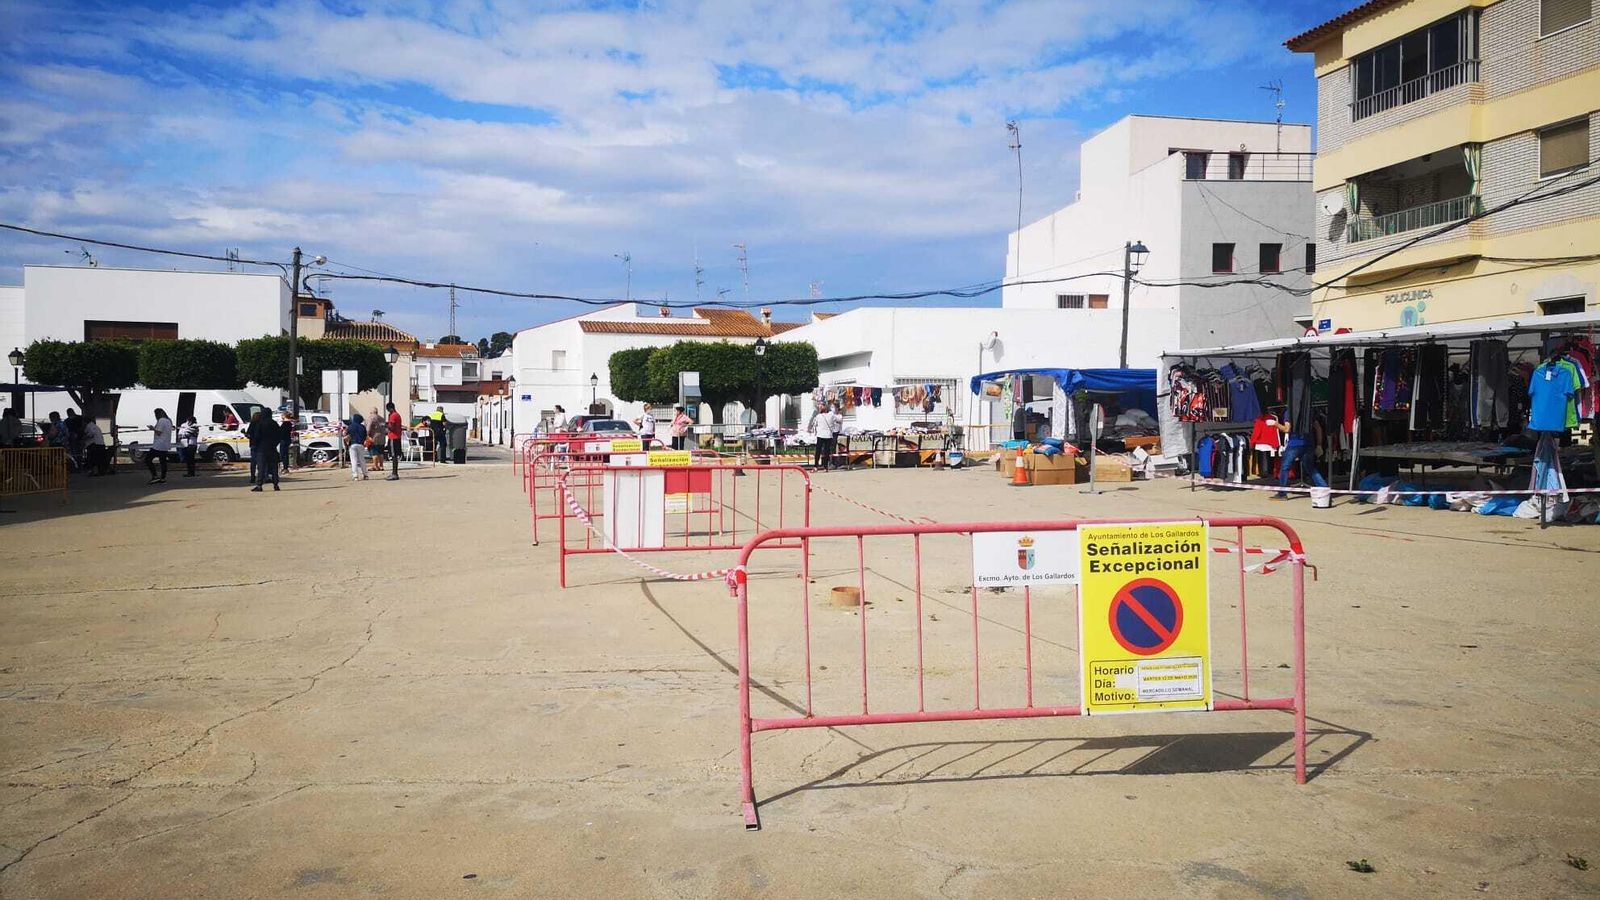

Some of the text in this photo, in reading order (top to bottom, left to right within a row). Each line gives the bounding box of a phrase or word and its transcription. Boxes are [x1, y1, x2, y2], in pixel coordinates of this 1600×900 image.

[1088, 532, 1138, 540] Ayuntamiento
[1166, 530, 1199, 538] Gallardos
[1087, 540, 1201, 556] Señalización
[1090, 556, 1199, 574] Excepcional
[1044, 572, 1075, 580] Gallardos
[1094, 665, 1134, 675] Horario
[1094, 692, 1135, 701] Motivo:
